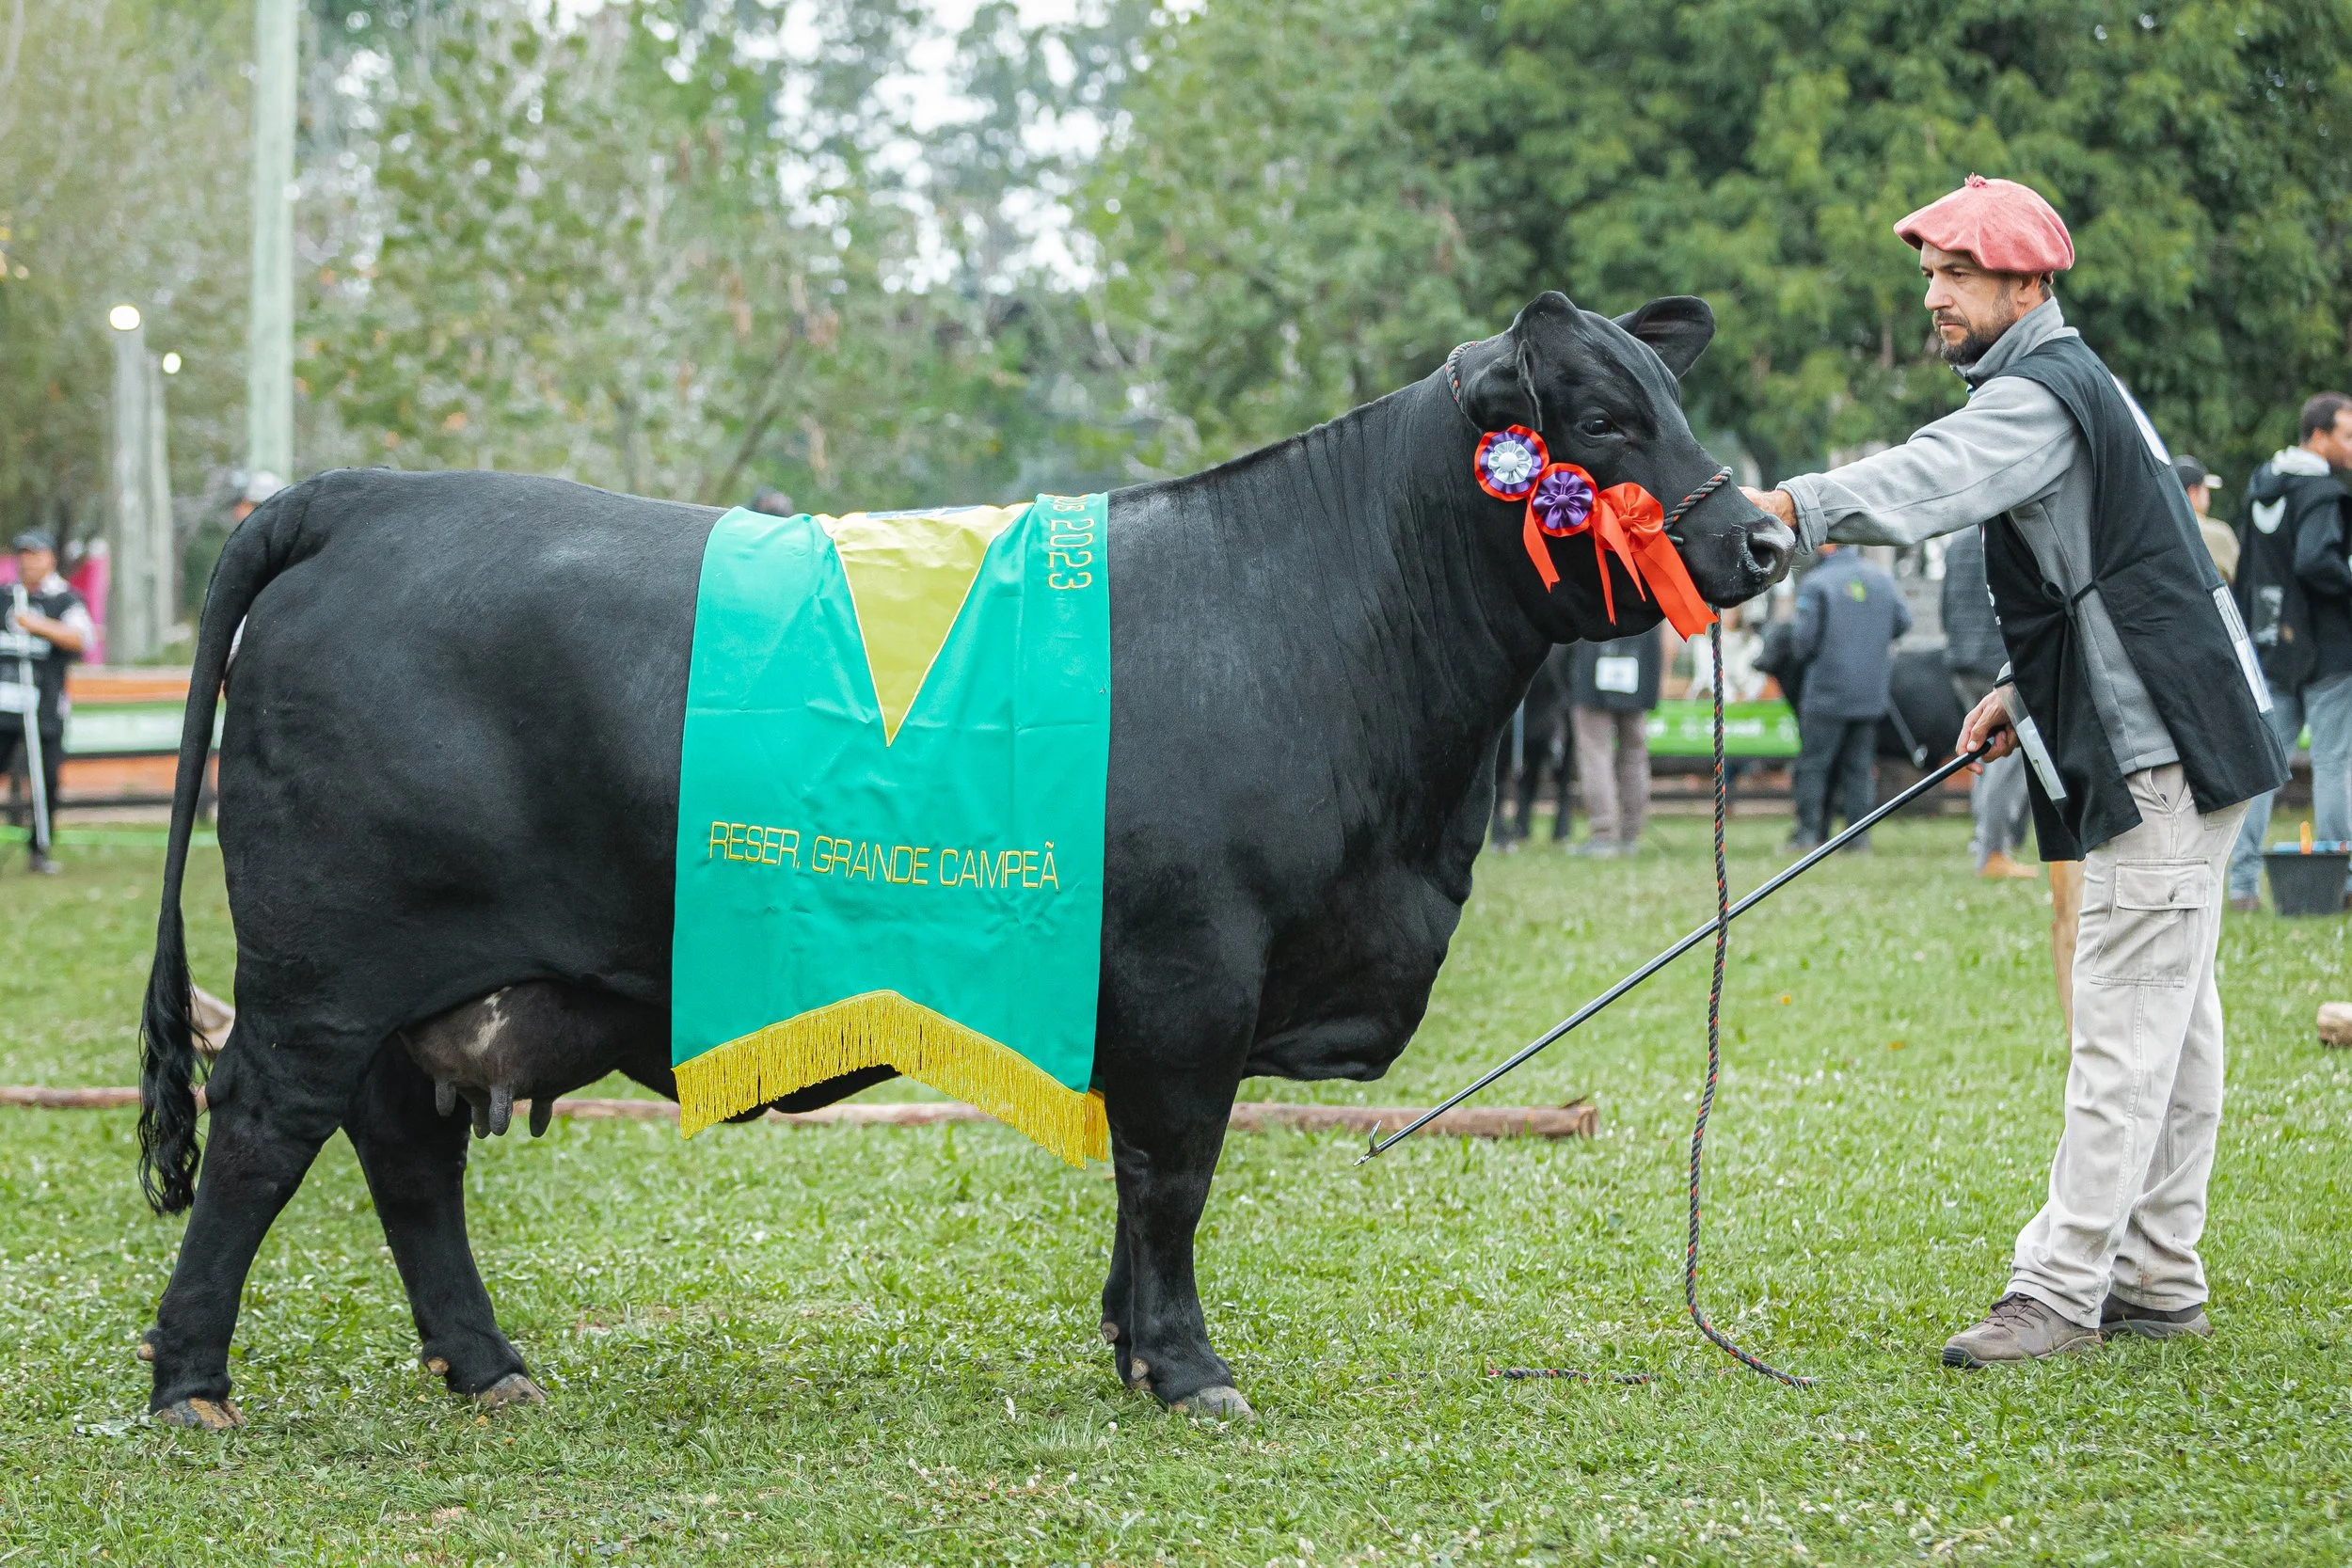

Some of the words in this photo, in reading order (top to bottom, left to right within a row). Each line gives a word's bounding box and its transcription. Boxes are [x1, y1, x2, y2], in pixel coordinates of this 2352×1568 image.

[1047, 517, 1095, 591] 2023
[811, 835, 930, 885] GRANDE
[939, 840, 1060, 890] CAMPEÃ
